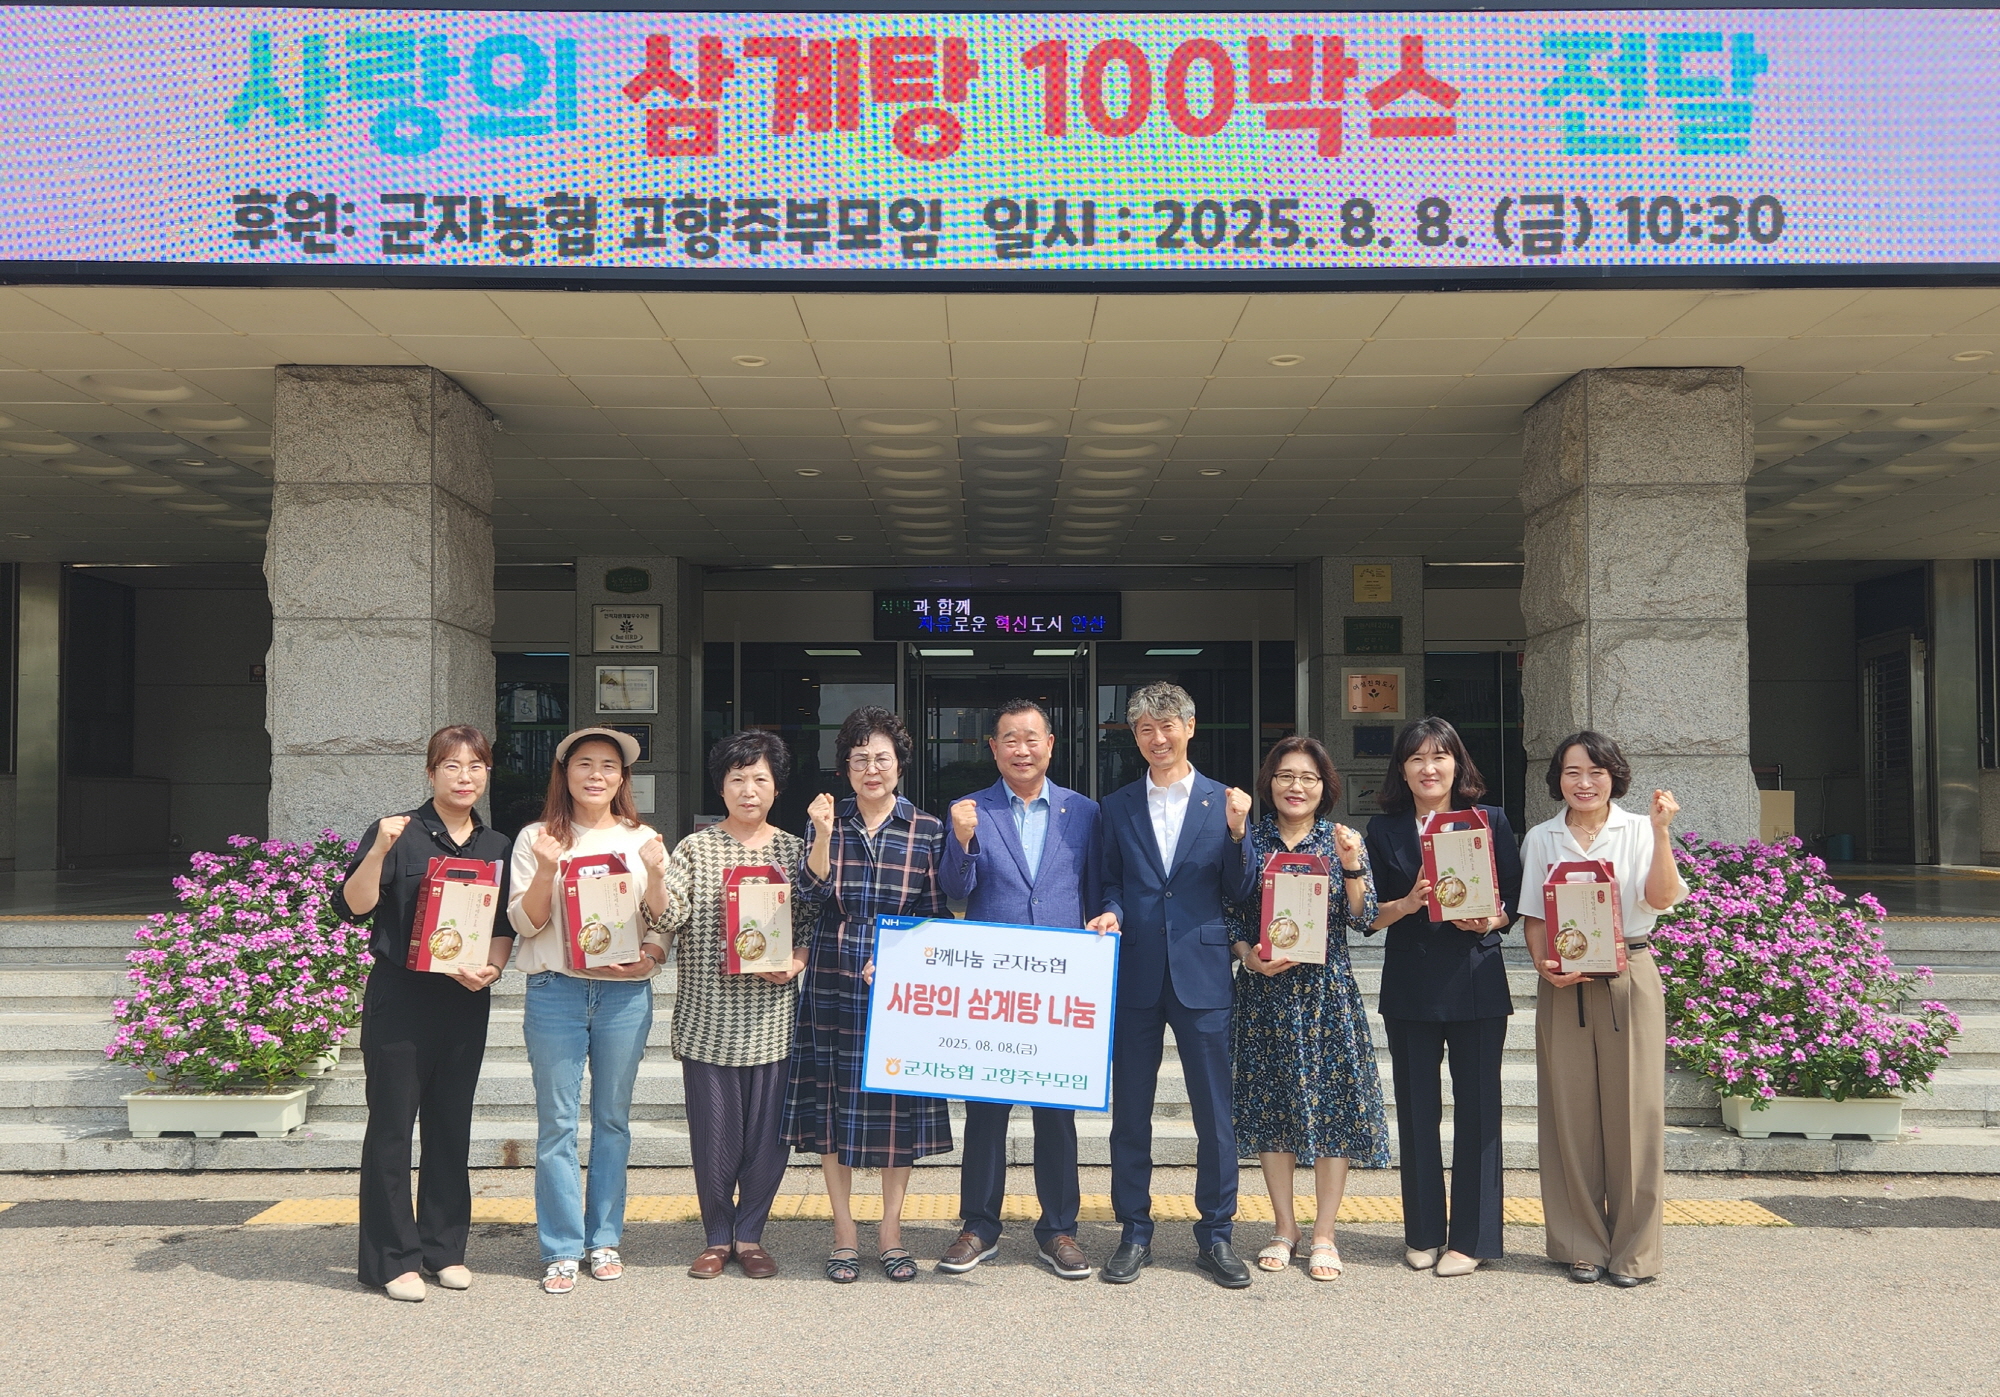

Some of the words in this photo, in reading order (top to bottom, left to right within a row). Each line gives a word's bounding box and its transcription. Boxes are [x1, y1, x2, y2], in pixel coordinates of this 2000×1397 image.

[225, 30, 578, 157] 사랑의
[622, 33, 980, 161] 삼계탕
[1019, 33, 1462, 157] 100박스
[1539, 31, 1769, 156] 전달
[232, 188, 355, 254] 후원:
[380, 192, 598, 258] 군자농협
[622, 193, 943, 259] 고향주부모임
[984, 199, 1095, 259] 일시
[1152, 198, 1319, 249] 2025.
[1339, 197, 1393, 248] 8.
[1415, 196, 1470, 247] 8.
[1493, 194, 1594, 256] (금)
[1614, 195, 1786, 246] 10:30
[937, 598, 971, 616] 함께
[994, 615, 1063, 633] 혁신도시
[1071, 615, 1106, 633] 안산
[881, 918, 899, 926] NH
[992, 953, 1067, 975] 군자농협
[887, 982, 961, 1018] 사랑의
[968, 988, 1042, 1024] 삼계탕
[1048, 995, 1096, 1029] 나눔
[938, 1037, 971, 1050] 2025.
[904, 1060, 974, 1081] 군자농협
[981, 1066, 1088, 1090] 고향주부모임
